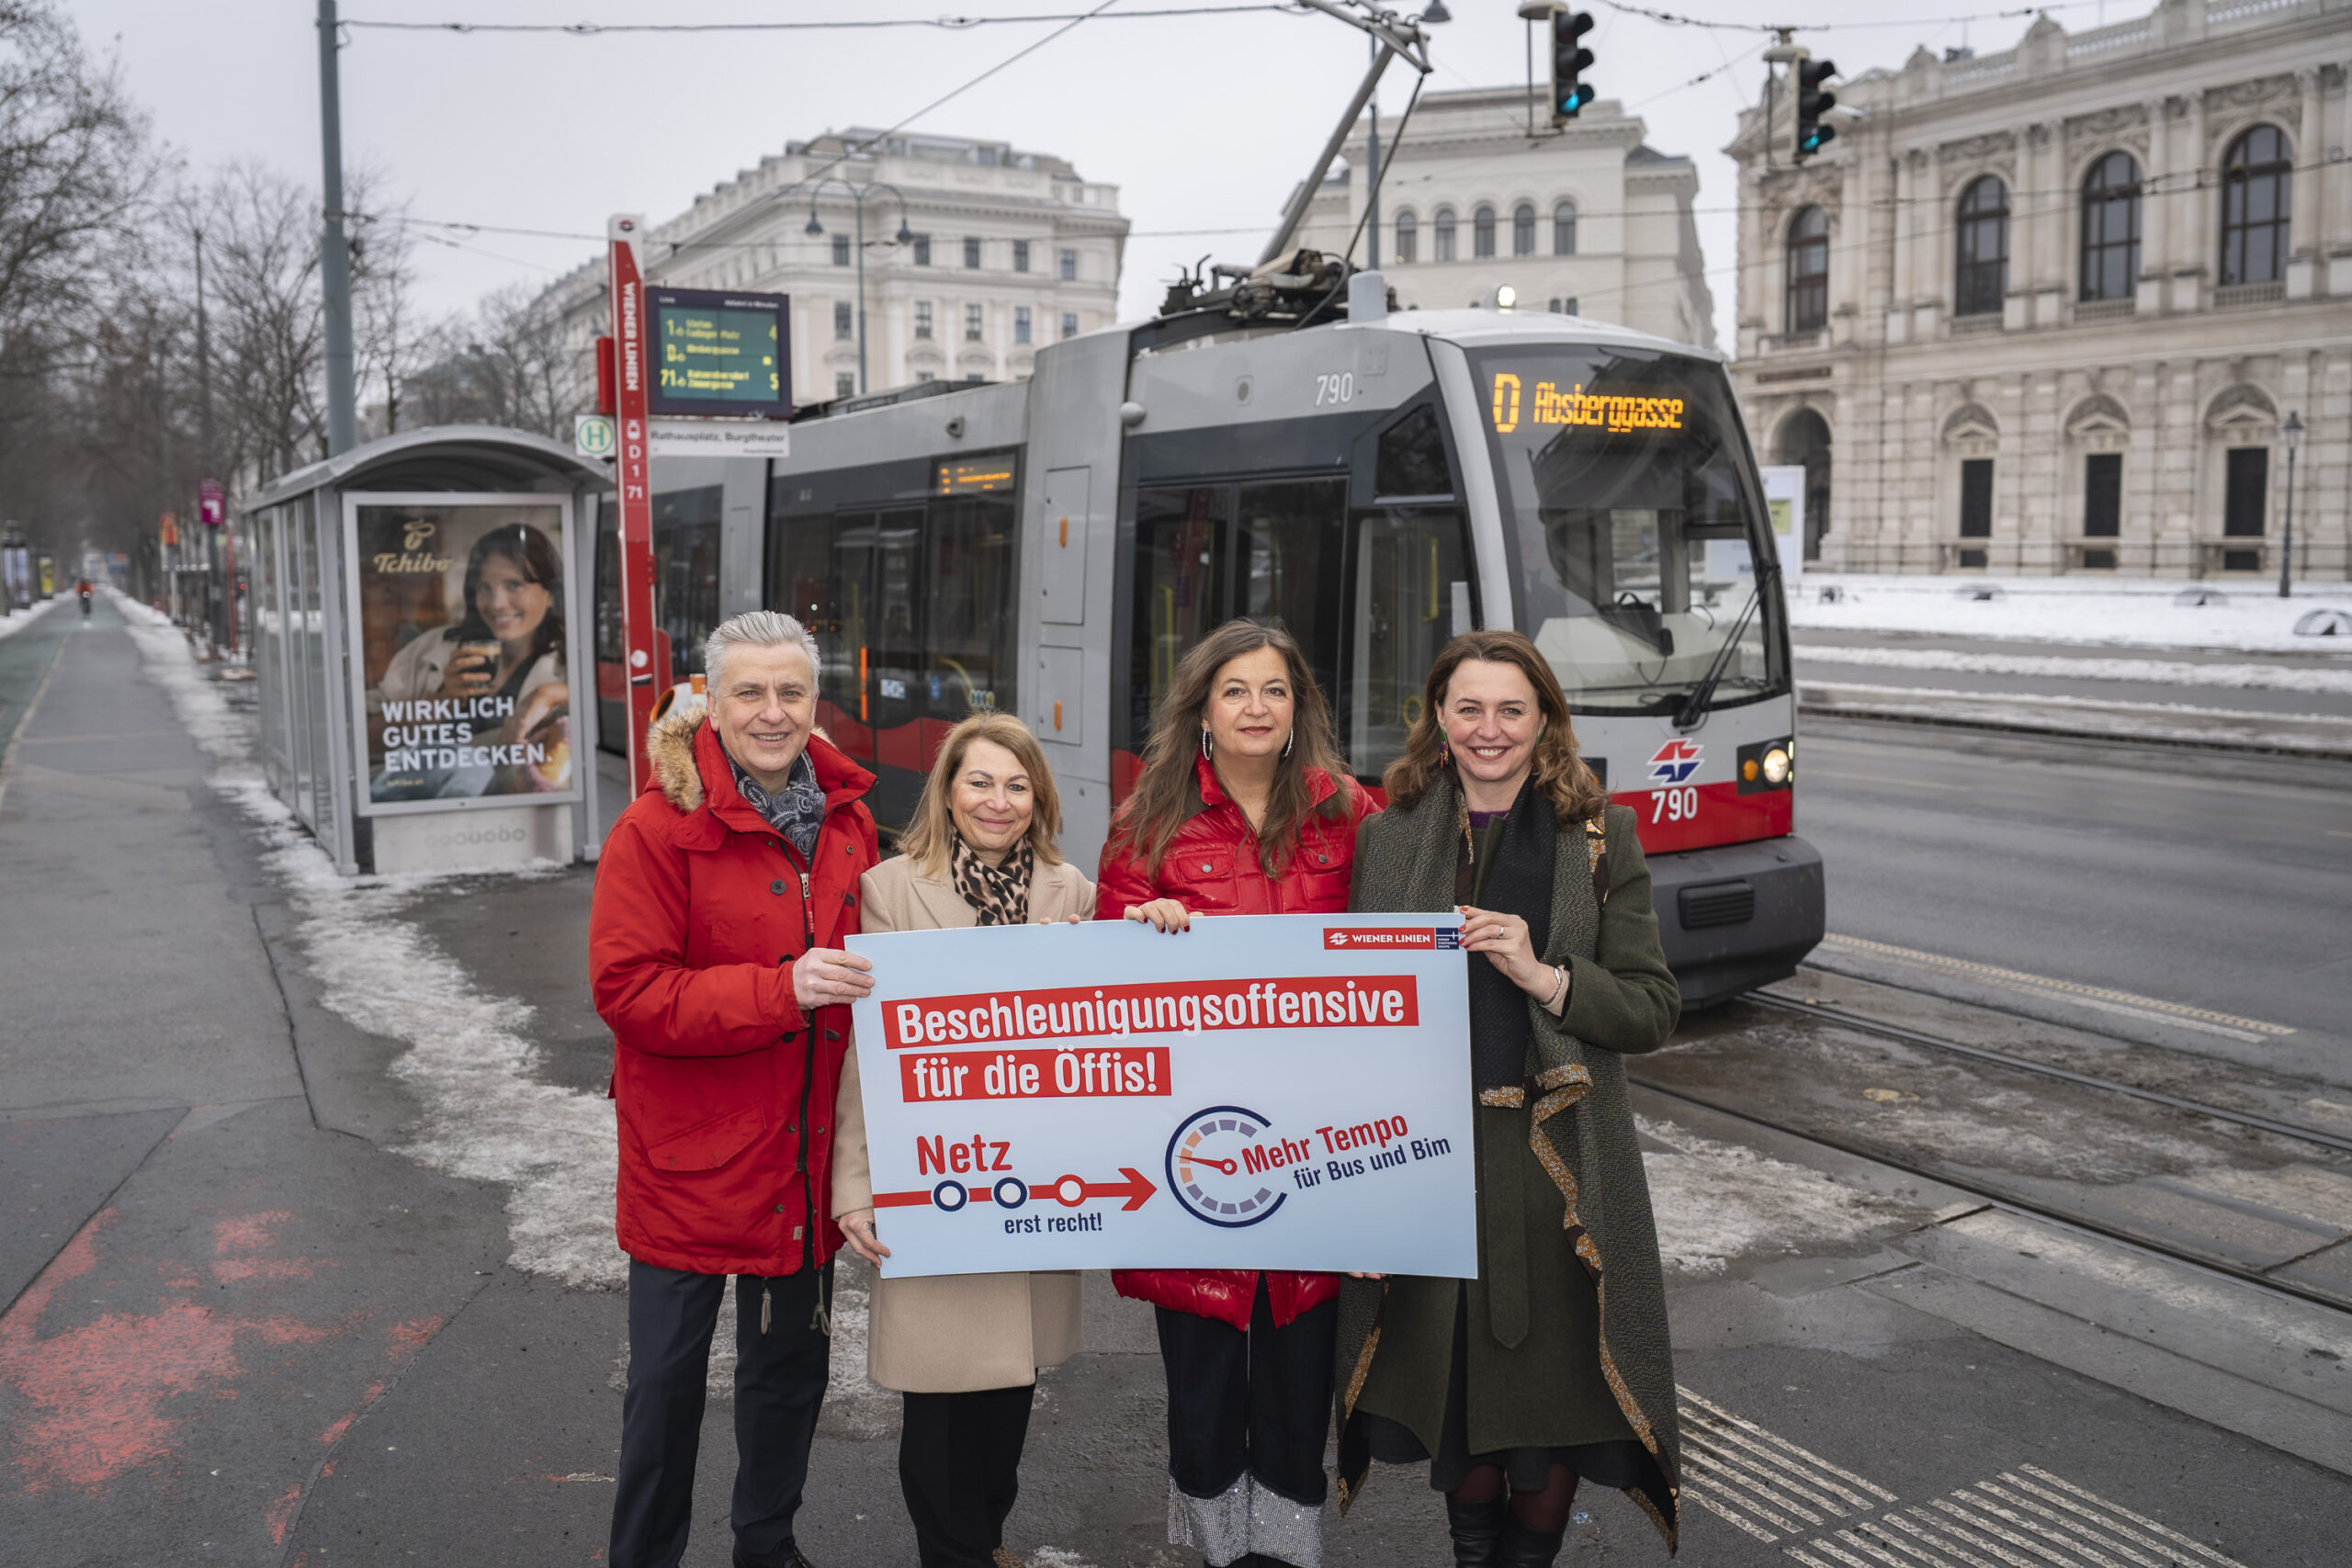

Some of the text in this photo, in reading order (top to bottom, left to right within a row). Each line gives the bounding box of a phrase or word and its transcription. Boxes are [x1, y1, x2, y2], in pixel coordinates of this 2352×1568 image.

[623, 281, 639, 391] WIENER LINIEN
[667, 319, 674, 336] 1
[769, 324, 778, 341] 4
[661, 368, 676, 387] 71
[770, 373, 779, 390] 5
[1316, 372, 1354, 406] 790
[1493, 373, 1685, 433] D Absberggasse
[587, 425, 605, 446] H
[628, 445, 641, 459] D
[631, 464, 639, 478] 1
[627, 485, 642, 499] 71
[373, 552, 454, 573] Tchibo
[381, 696, 514, 723] WIRKLICH
[382, 722, 473, 748] GUTES
[384, 742, 553, 773] ENTDECKEN.
[1651, 786, 1699, 825] 790
[1351, 933, 1431, 943] WIENER LINIEN
[896, 979, 1405, 1044] Beschleunigungsoffensive
[912, 1043, 1158, 1099] für die Öffis!
[916, 1134, 1013, 1176] Netz
[1241, 1114, 1409, 1176] Mehr Tempo
[1293, 1137, 1452, 1190] für Bus und Bim
[1004, 1212, 1102, 1235] erst recht!
